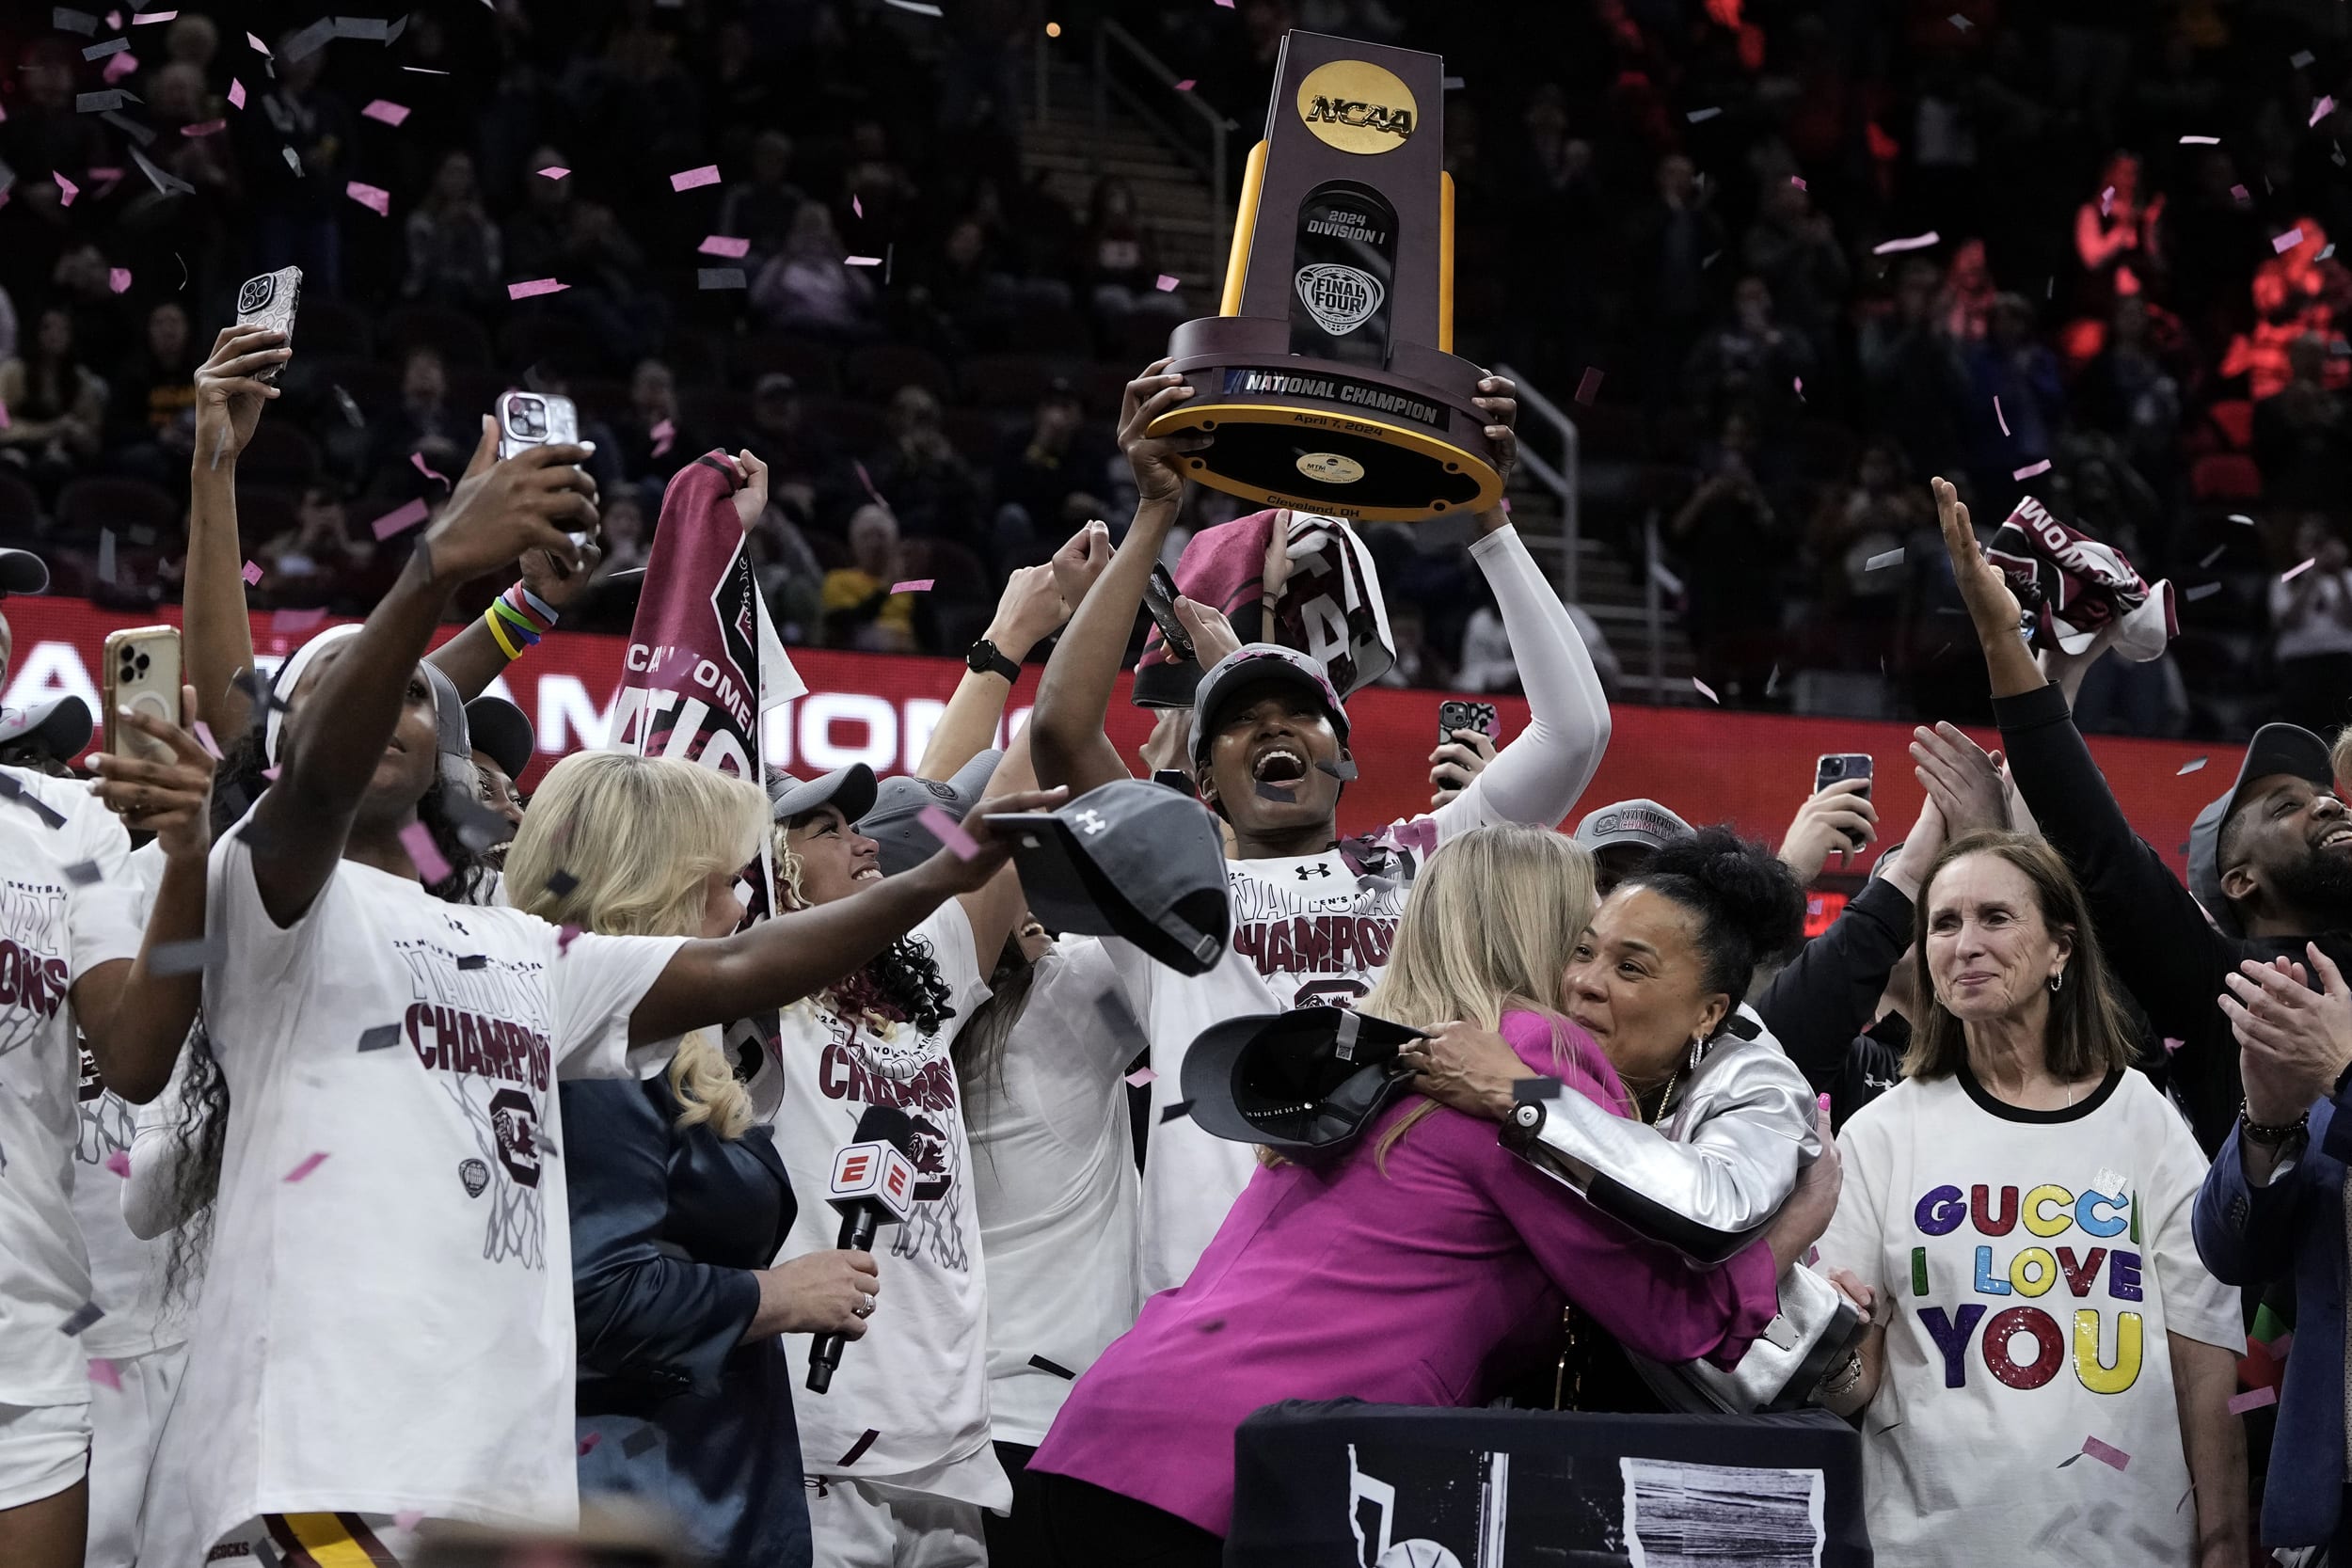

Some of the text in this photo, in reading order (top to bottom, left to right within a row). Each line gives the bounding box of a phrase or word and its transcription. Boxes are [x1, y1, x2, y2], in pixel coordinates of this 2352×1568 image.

[1306, 94, 1412, 139] NCAA
[1328, 210, 1366, 227] 2024
[1307, 219, 1386, 245] DIVISION I
[1316, 277, 1364, 299] FINAL
[1314, 292, 1362, 313] FOUR
[1245, 372, 1438, 424] NATIONAL CHAMPION
[1294, 413, 1327, 426] April
[1344, 421, 1384, 436] 2024
[1266, 495, 1360, 518] Cleveland, OH
[1914, 1183, 2140, 1245] GUCCI
[1911, 1245, 2143, 1303] I LOVE
[1916, 1304, 2143, 1395] YOU
